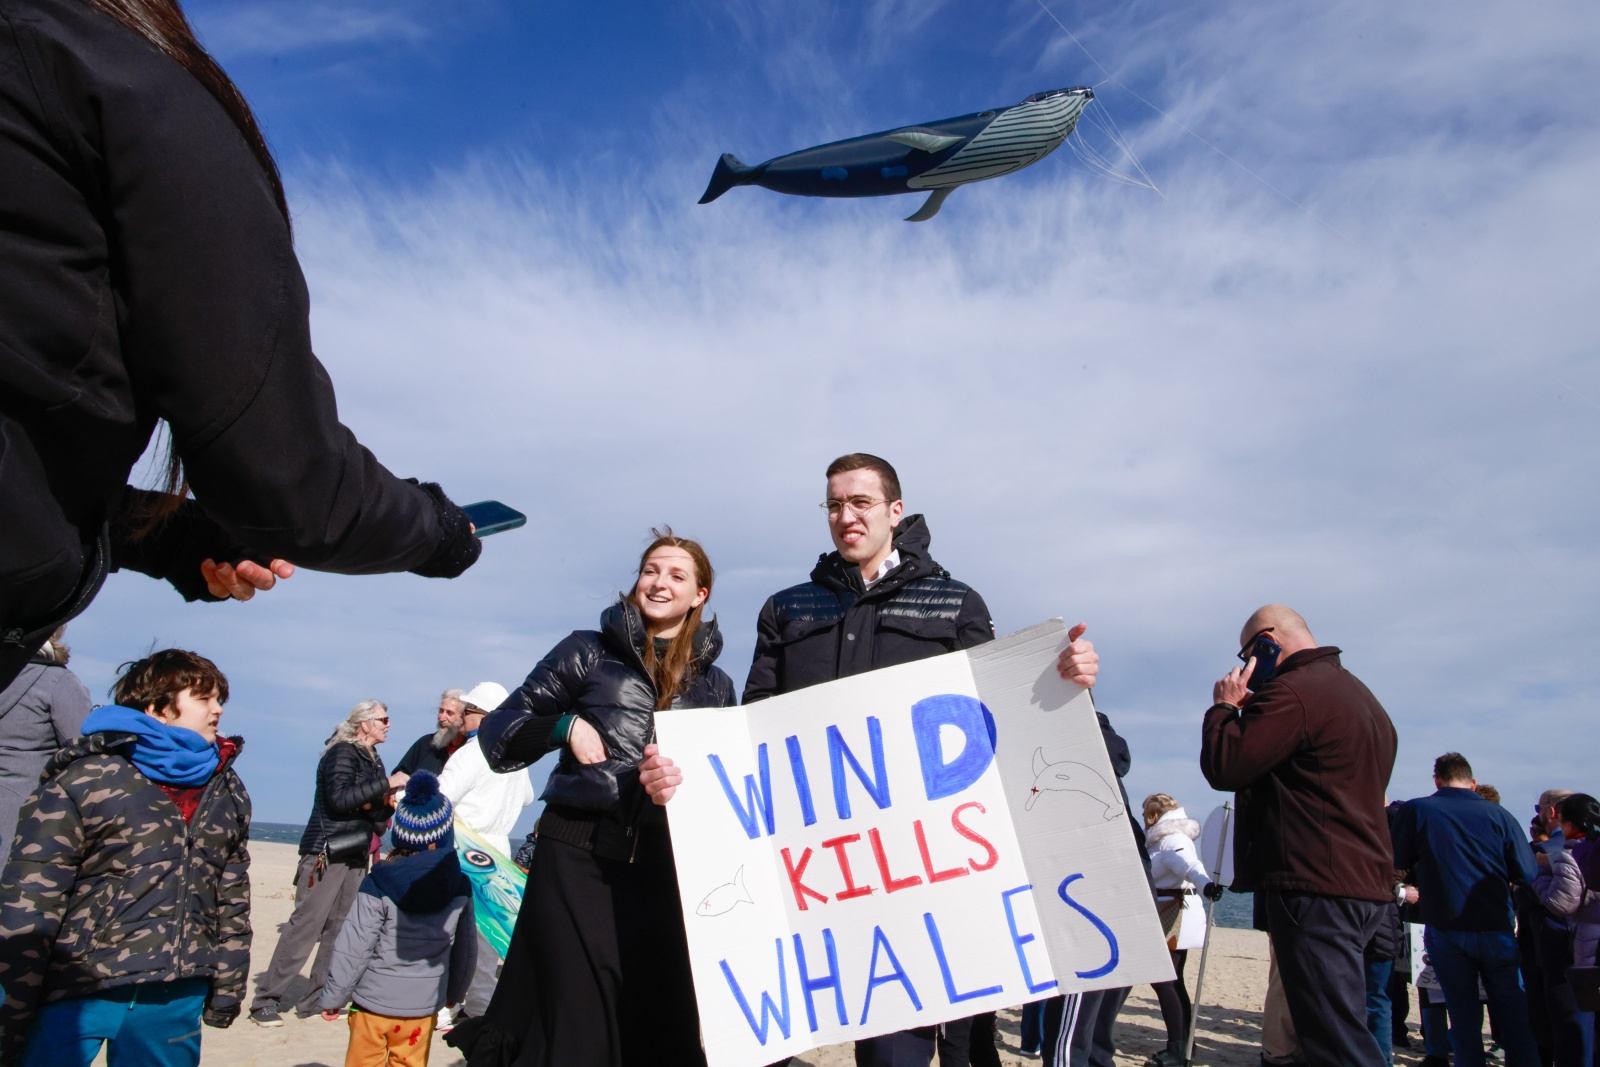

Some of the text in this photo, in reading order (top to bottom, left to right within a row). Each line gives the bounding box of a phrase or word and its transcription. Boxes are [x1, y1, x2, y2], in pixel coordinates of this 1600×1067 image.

[707, 693, 997, 839] WIND
[780, 801, 999, 910] KILLS
[719, 873, 1120, 1046] WHALES
